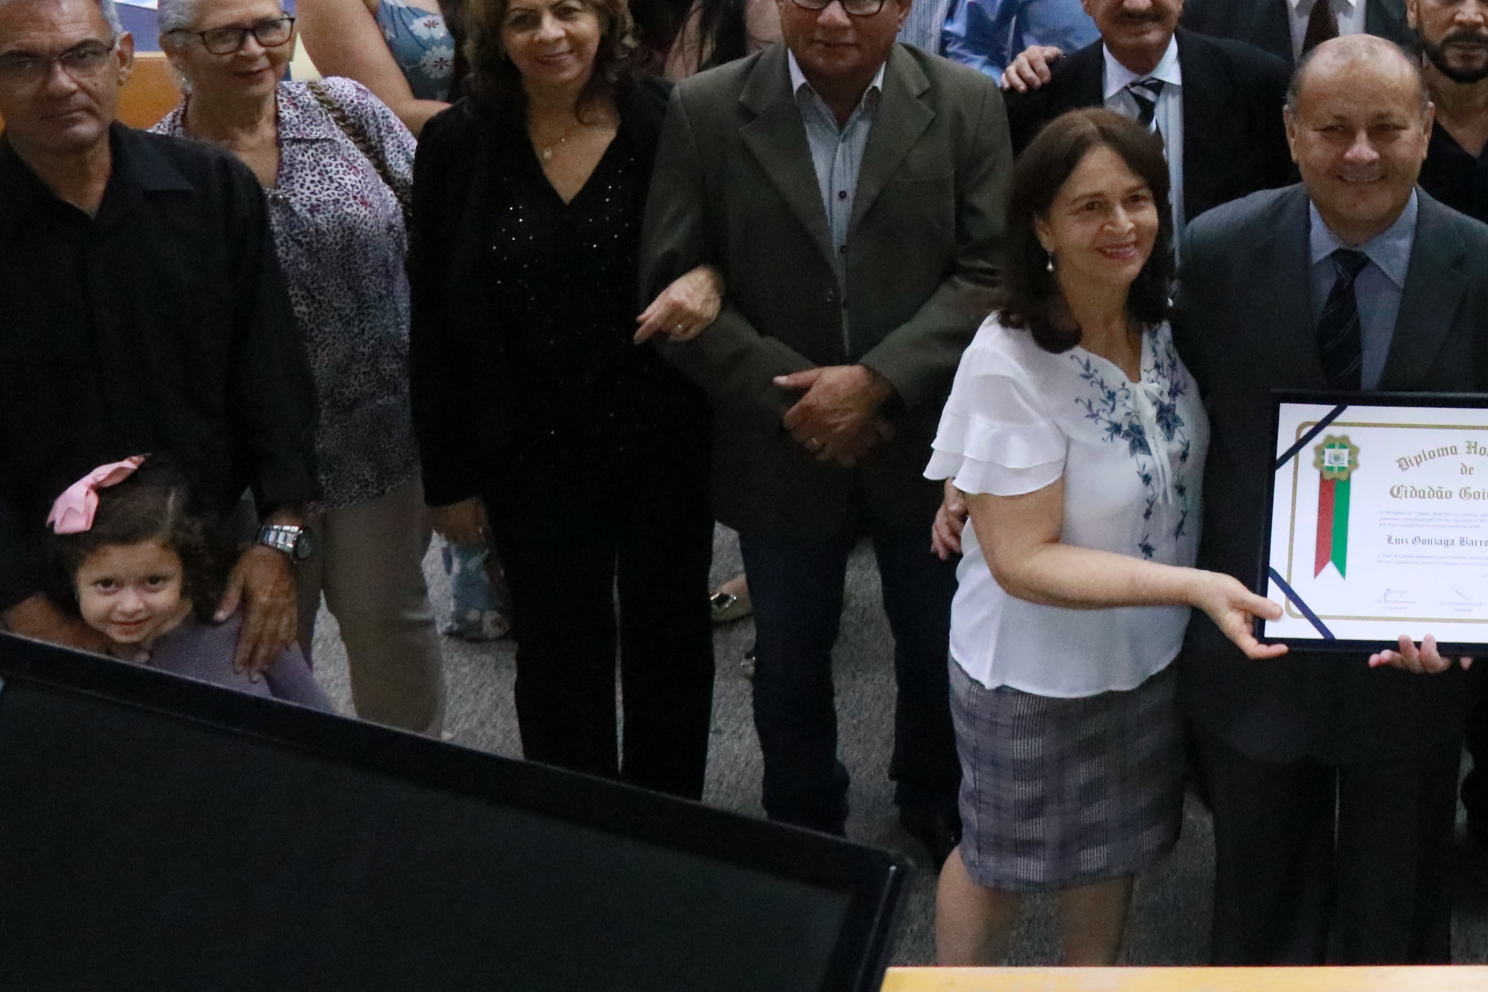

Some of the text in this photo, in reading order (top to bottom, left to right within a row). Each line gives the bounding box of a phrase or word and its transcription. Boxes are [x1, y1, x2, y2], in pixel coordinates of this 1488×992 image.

[1395, 445, 1459, 472] Diploma
[1459, 462, 1475, 476] de
[1389, 484, 1453, 500] Cidadão
[1411, 535, 1455, 548] Gonzaga
